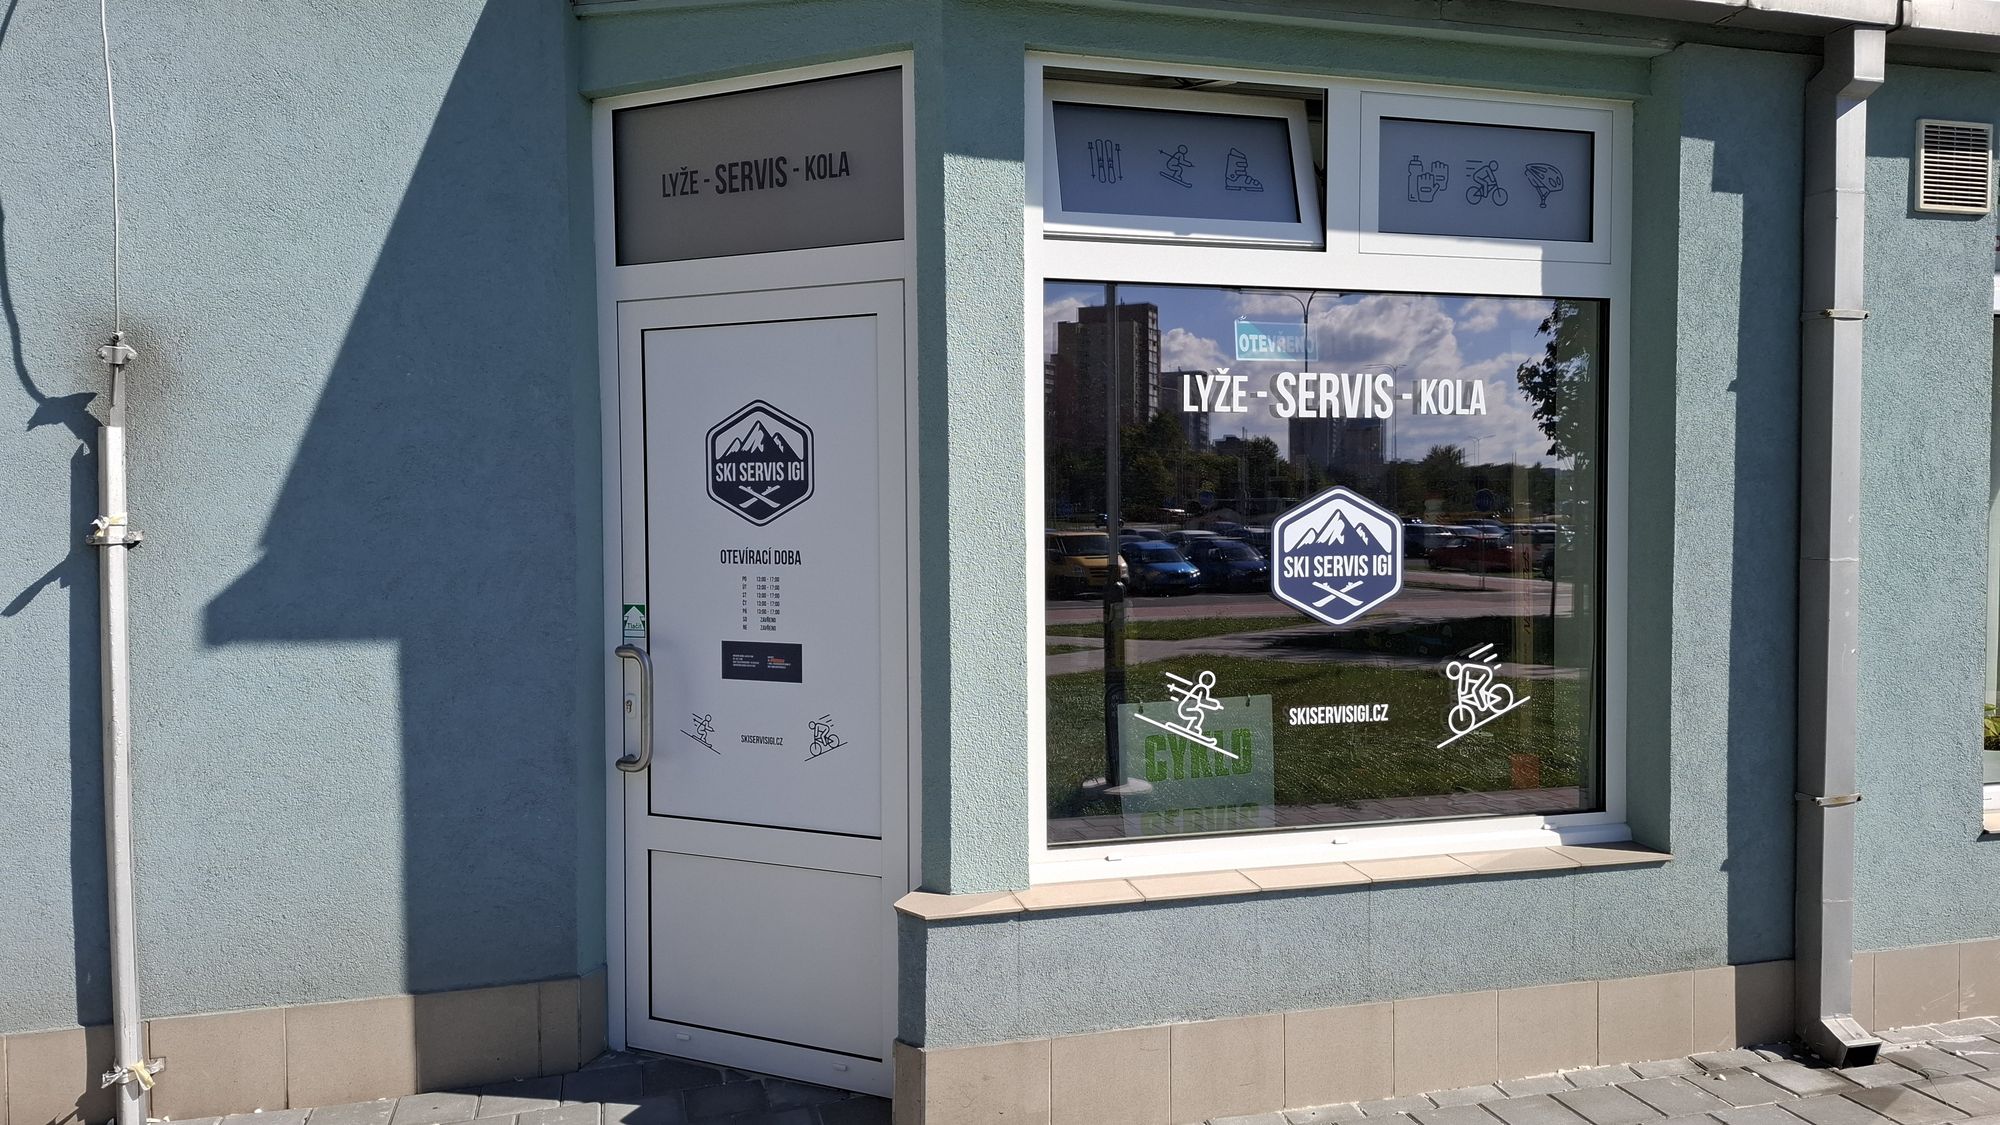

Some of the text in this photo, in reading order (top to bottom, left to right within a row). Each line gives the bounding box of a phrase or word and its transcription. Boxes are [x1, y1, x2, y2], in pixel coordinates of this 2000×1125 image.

[662, 166, 699, 198] LYŽE
[715, 156, 787, 195] SERVIS
[805, 151, 850, 181] KOLA
[1183, 367, 1248, 413] LYŽE
[1276, 372, 1394, 419] SERVIS
[1420, 379, 1487, 415] KOLA
[715, 461, 805, 482] SKI SERVIS IGI
[720, 546, 802, 566] OTEVÍRACÍ DOBA
[1283, 554, 1392, 578] SKI SERVIS IGI
[1289, 704, 1389, 726] SKISERVISIGI.CZ
[741, 734, 784, 746] SKISERVISIGI.CZ
[1144, 728, 1252, 782] CYKLO
